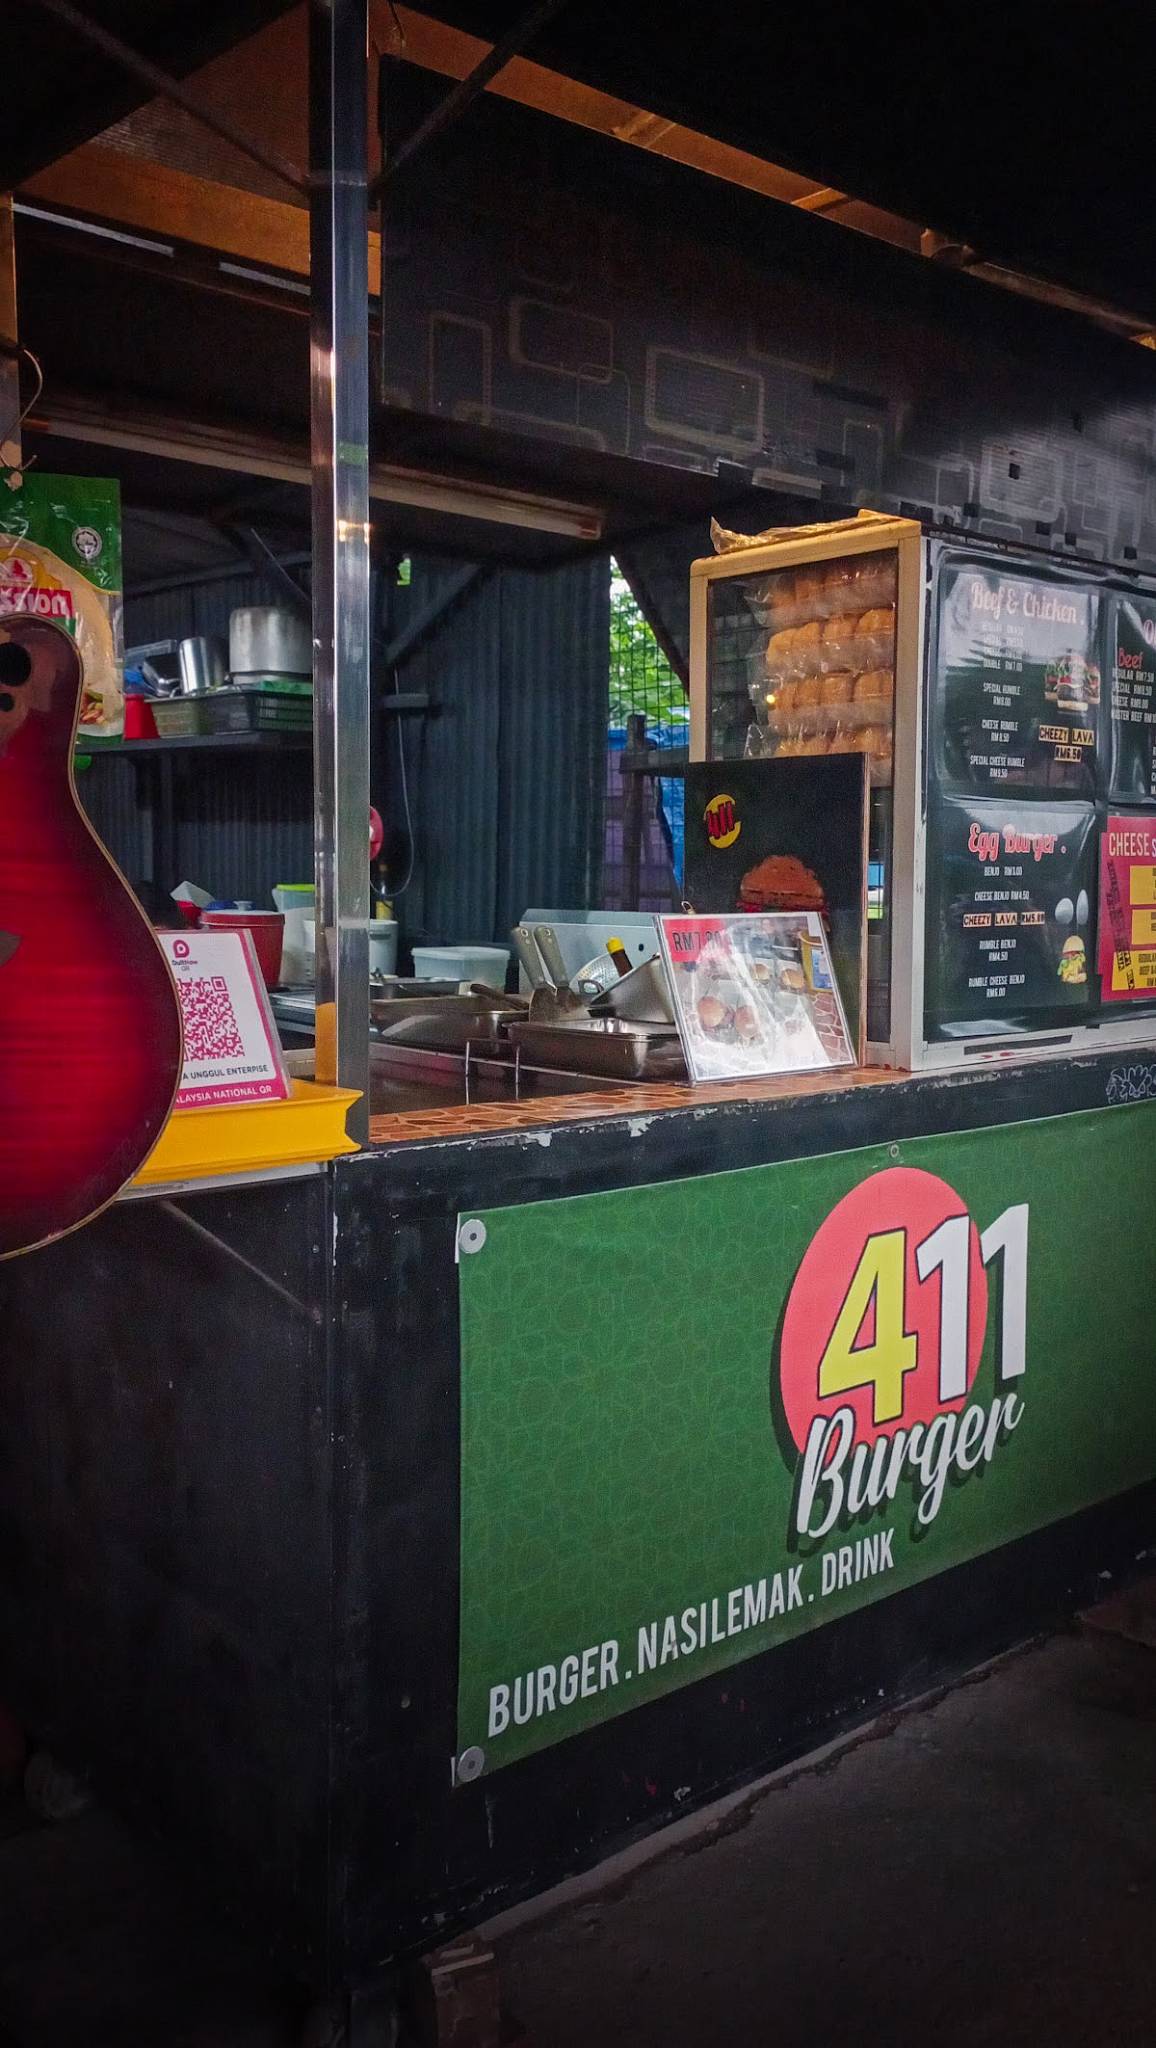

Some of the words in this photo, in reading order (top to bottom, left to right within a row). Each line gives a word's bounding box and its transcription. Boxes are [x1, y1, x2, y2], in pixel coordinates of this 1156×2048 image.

[971, 581, 1005, 620] Beef
[1039, 726, 1069, 743] CHEEZY
[1072, 729, 1094, 745] LAVA
[968, 822, 1000, 861] Egg
[1002, 823, 1058, 862] Burger
[1108, 832, 1150, 857] CHEESE
[963, 913, 991, 927] CHEEZY
[995, 912, 1018, 926] LAVA
[190, 1069, 225, 1080] UNGGUL
[213, 1086, 257, 1099] NATIONAL
[259, 1085, 272, 1094] QR
[818, 1203, 1030, 1427] 411
[797, 1393, 1025, 1539] Burger
[821, 1528, 895, 1597] DRINK
